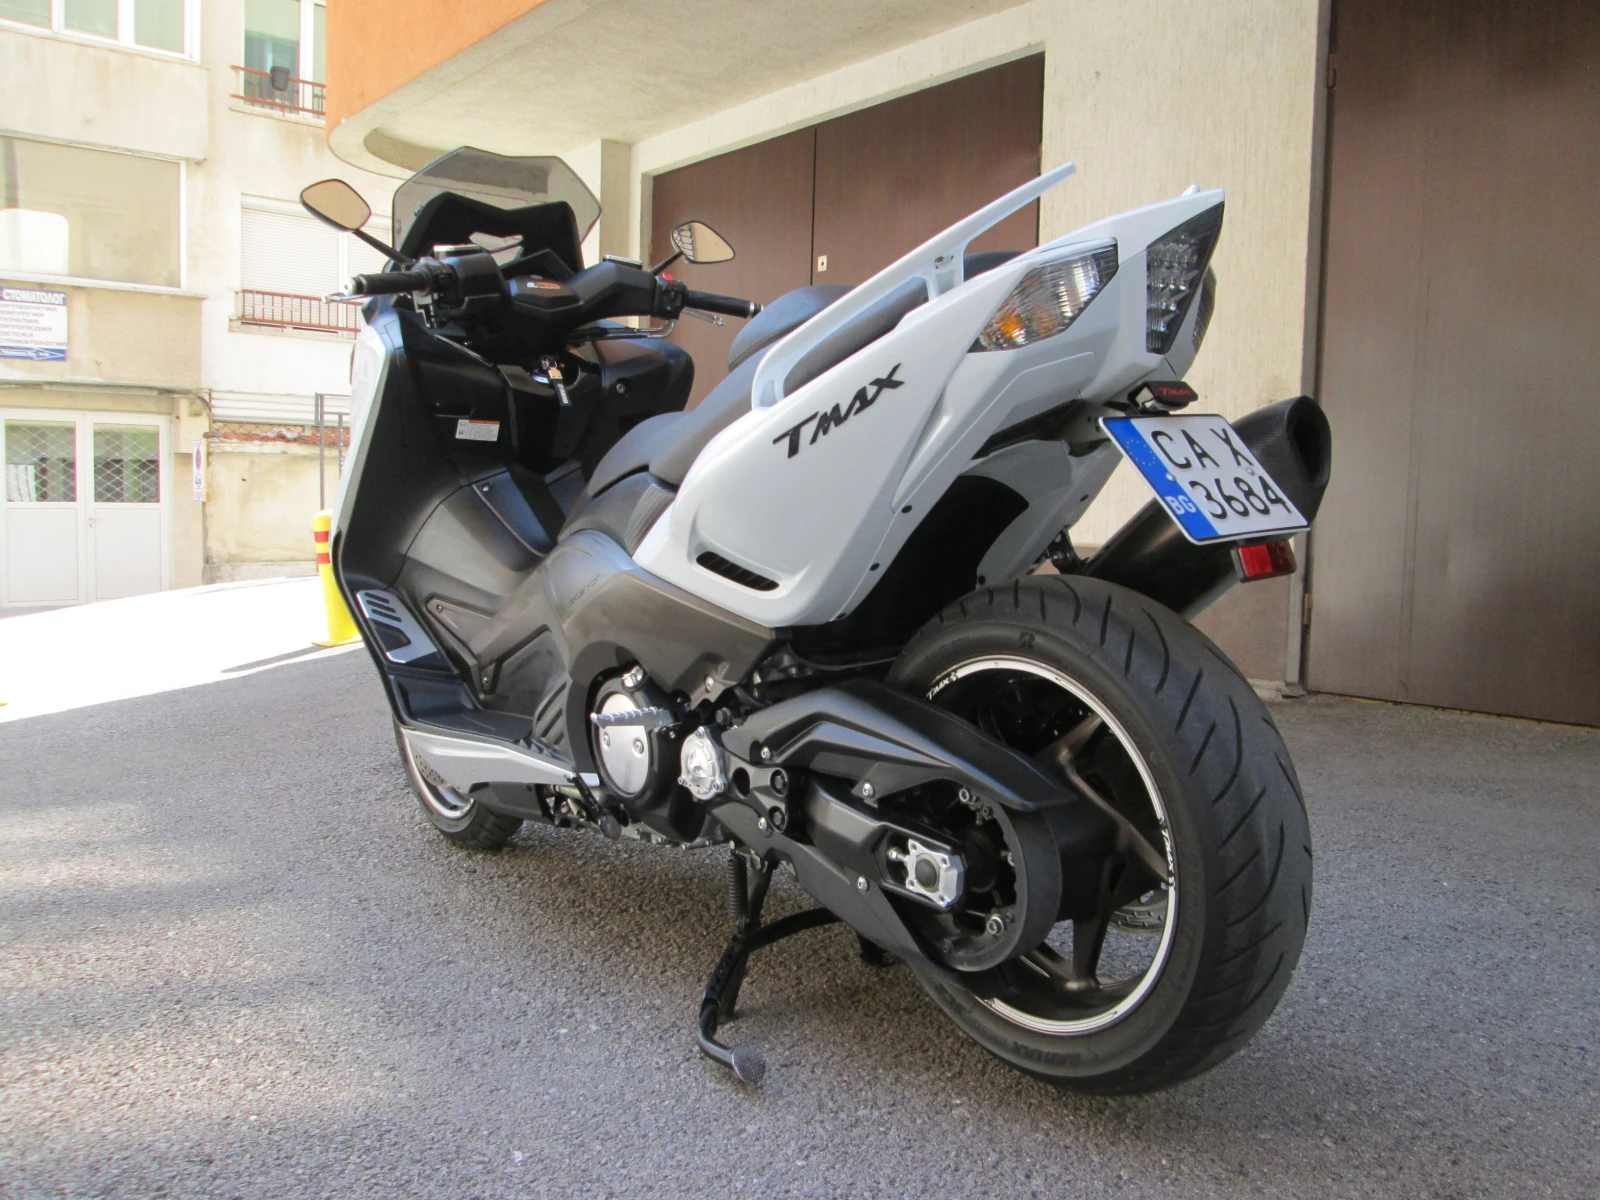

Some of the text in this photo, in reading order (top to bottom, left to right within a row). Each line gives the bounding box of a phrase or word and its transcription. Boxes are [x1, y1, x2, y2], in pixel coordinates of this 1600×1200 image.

[3, 288, 66, 304] СТОМАТОЛОГ
[773, 362, 905, 459] TMAX
[1151, 428, 1254, 470] CA X
[1165, 495, 1198, 516] BG
[1187, 475, 1292, 520] 3684
